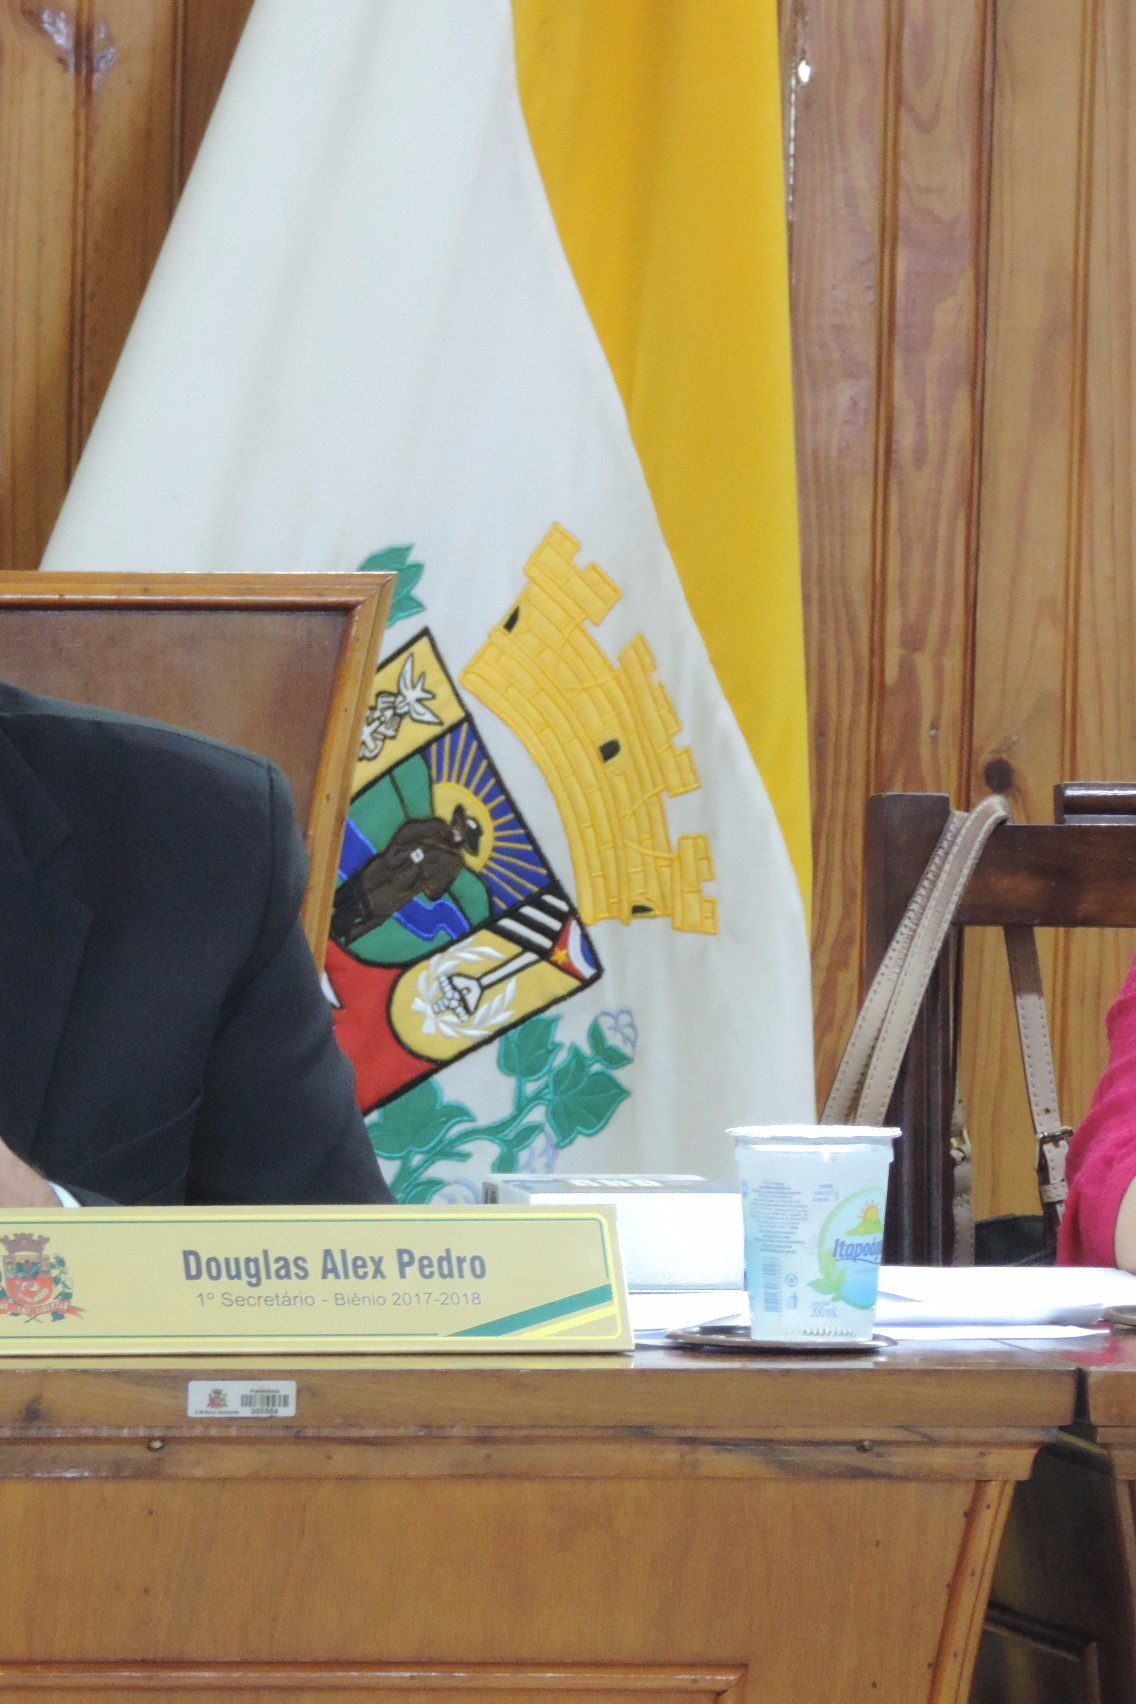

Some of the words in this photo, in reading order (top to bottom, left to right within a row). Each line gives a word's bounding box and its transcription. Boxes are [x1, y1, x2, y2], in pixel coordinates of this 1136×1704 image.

[182, 1249, 310, 1288] Douglas
[321, 1248, 387, 1280] Alex
[396, 1248, 487, 1280] Pedro
[220, 1291, 315, 1307] Secretário
[334, 1292, 387, 1307] Biênio
[391, 1291, 482, 1306] 2017-2018
